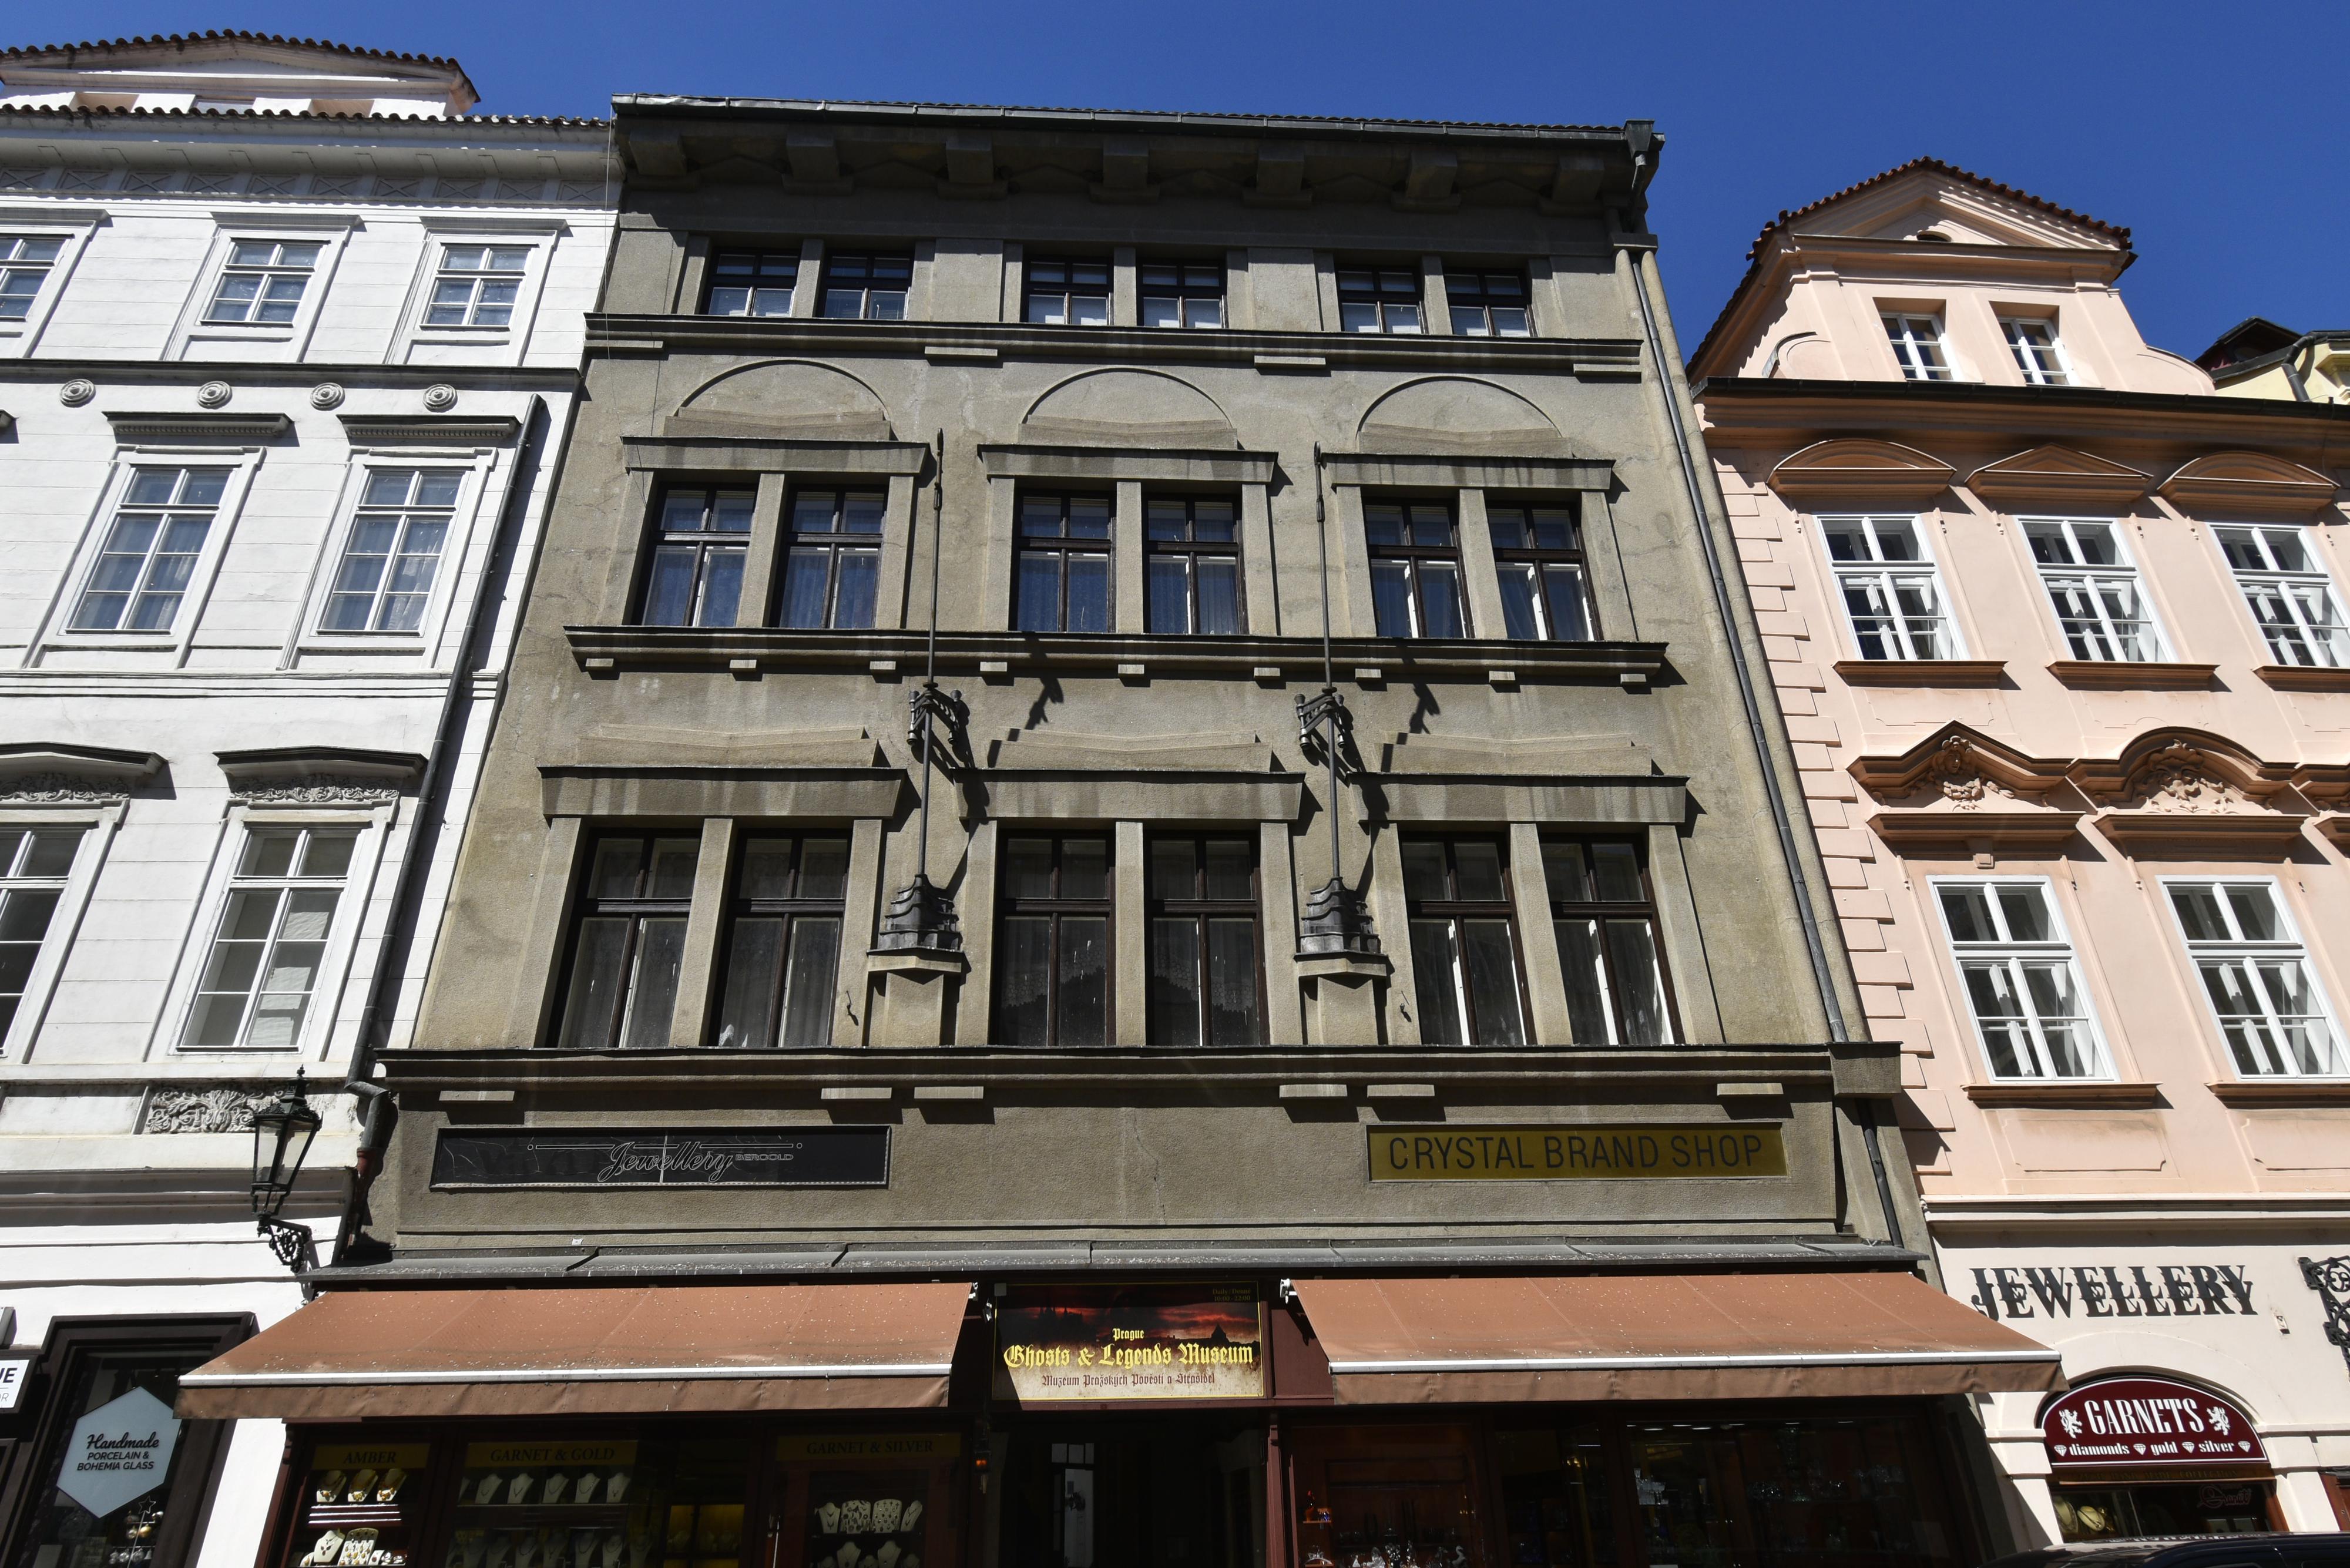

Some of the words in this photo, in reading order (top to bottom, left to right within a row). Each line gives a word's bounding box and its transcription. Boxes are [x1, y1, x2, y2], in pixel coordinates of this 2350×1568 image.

[1389, 1136, 1534, 1170] CRYSTAL
[1544, 1135, 1659, 1169] BRAND
[1671, 1134, 1762, 1167] SHOP
[597, 1141, 733, 1183] Jewellery
[1970, 1265, 2252, 1304] JEWELLERY
[1112, 1328, 1144, 1341] Prague
[1003, 1344, 1070, 1370] Ghosts
[1077, 1347, 1096, 1366] &
[1099, 1343, 1172, 1369] Legends
[1178, 1343, 1254, 1365] Museum
[1042, 1375, 1079, 1387] Muzeum
[1167, 1375, 1172, 1384] a
[1175, 1372, 1214, 1384] Strašidel
[2084, 1398, 2204, 1435] GARNETS
[86, 1431, 160, 1449] Handmade
[807, 1442, 866, 1455] GARNET
[870, 1442, 881, 1454] &
[885, 1440, 934, 1453] SILVER
[87, 1451, 142, 1460] PORCELAIN
[490, 1448, 553, 1462] GARNET
[555, 1448, 566, 1461] &
[570, 1446, 615, 1460] GOLD
[2069, 1443, 2130, 1456] diamonds
[2150, 1441, 2179, 1456] gold
[2198, 1441, 2235, 1453] silver
[343, 1451, 396, 1464] AMBER
[76, 1462, 120, 1470] BOHEMIA
[123, 1461, 155, 1470] GLASS
